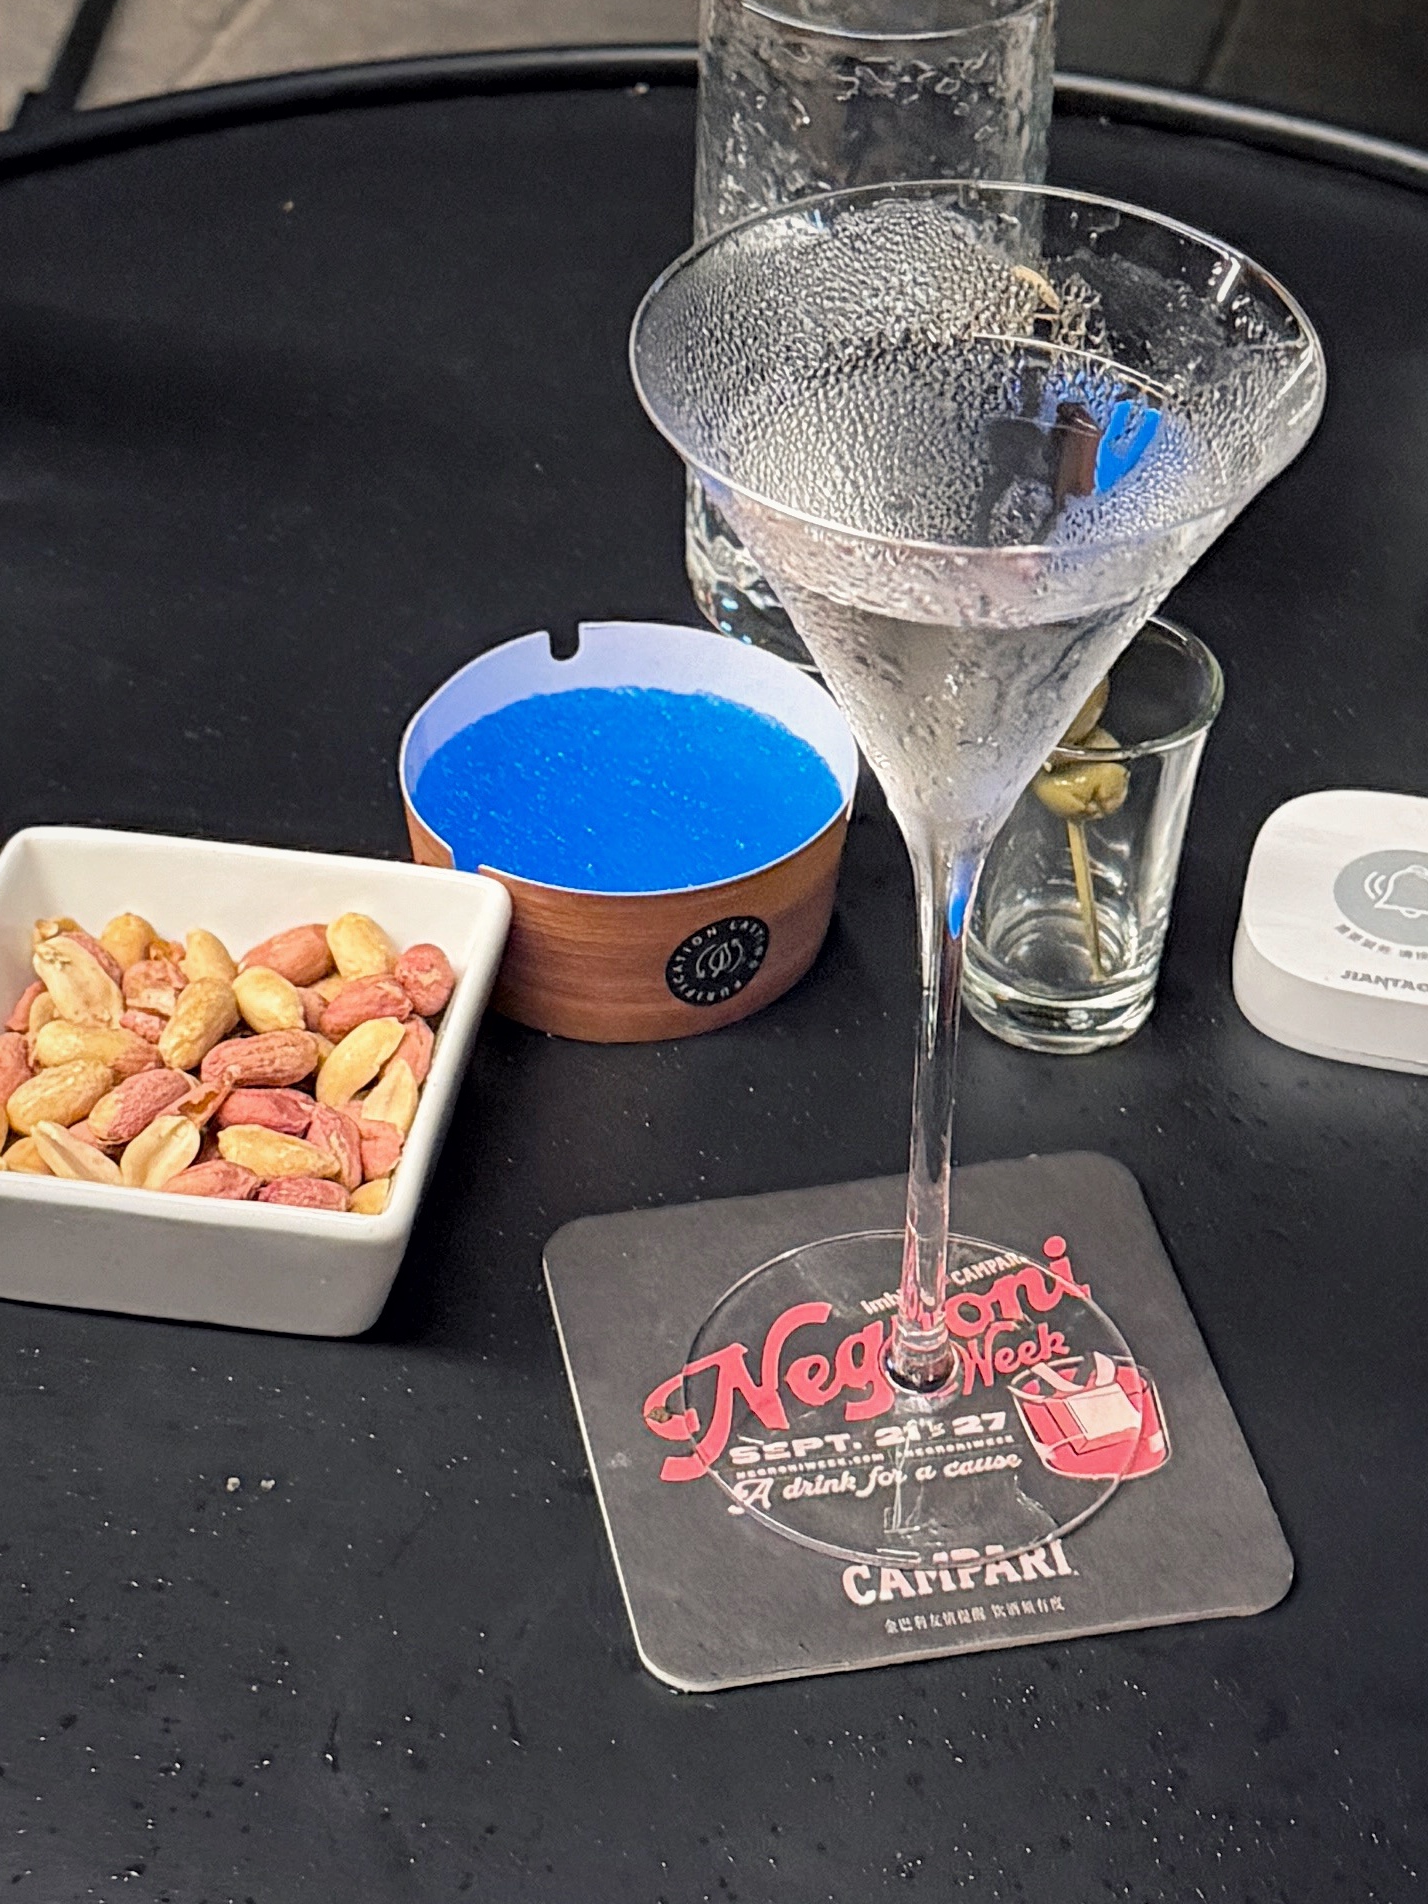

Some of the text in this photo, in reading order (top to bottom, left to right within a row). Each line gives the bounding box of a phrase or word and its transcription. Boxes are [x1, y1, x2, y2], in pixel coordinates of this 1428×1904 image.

[642, 1235, 1090, 1483] Negoni
[961, 1322, 1071, 1396] Week
[729, 1433, 863, 1465] SEPT.
[952, 1411, 1006, 1436] 27
[782, 1470, 857, 1500] drink
[855, 1465, 908, 1498] for
[915, 1465, 937, 1482] a
[943, 1453, 1022, 1477] cause
[841, 1539, 1072, 1606] CAMPARI
